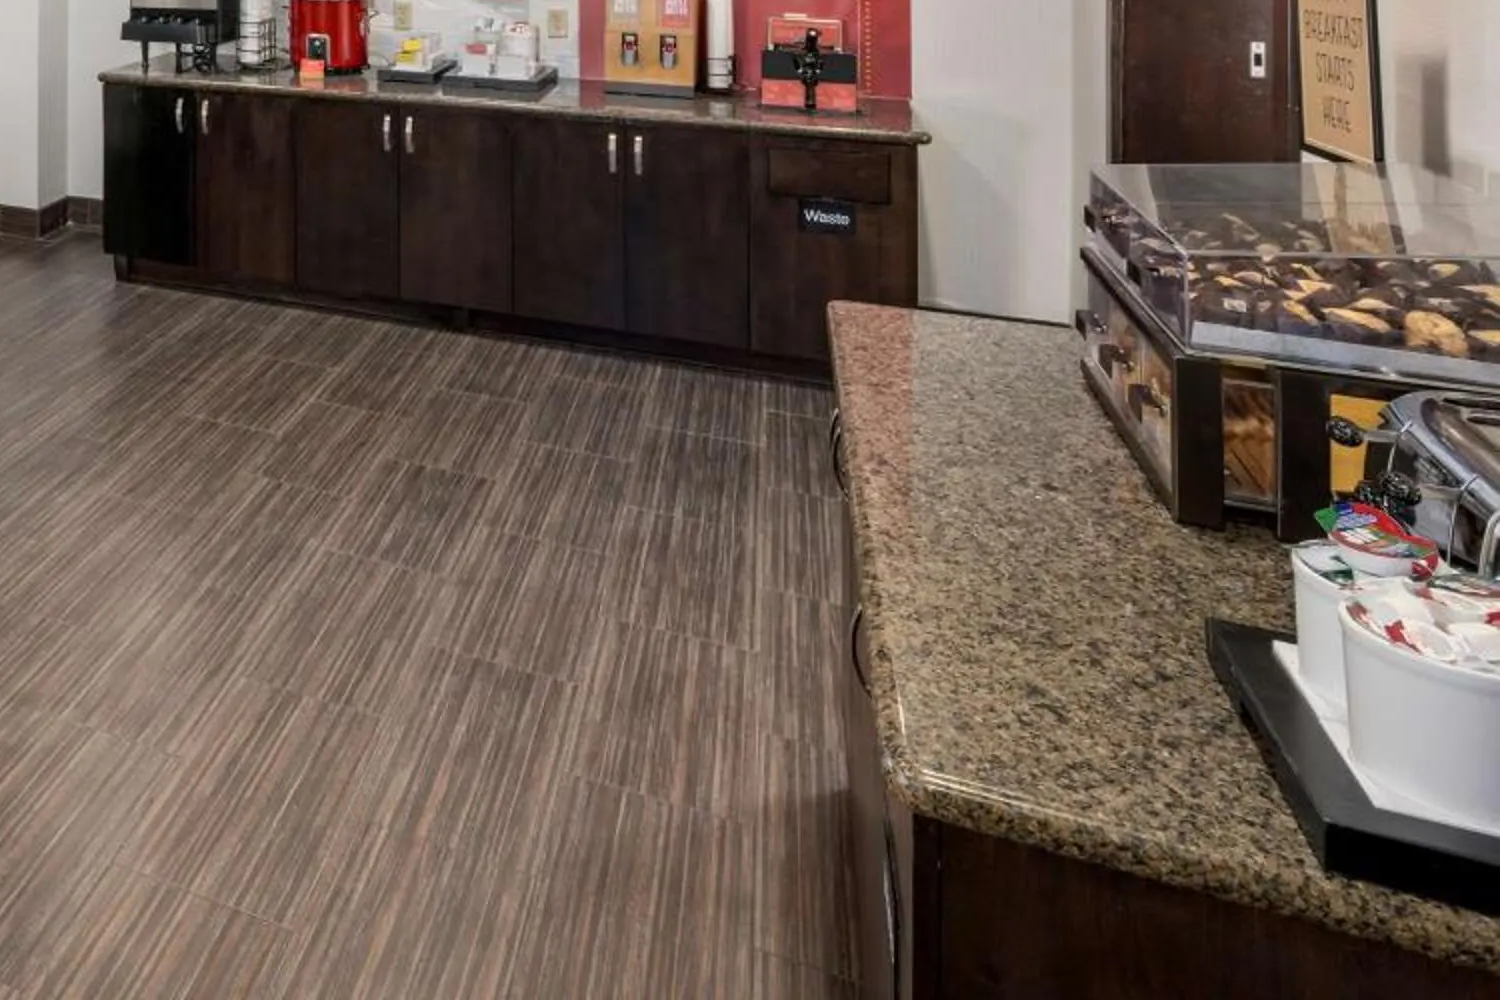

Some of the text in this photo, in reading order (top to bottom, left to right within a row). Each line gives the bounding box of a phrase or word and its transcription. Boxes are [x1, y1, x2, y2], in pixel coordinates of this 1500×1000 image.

[1303, 9, 1363, 49] BREAKFAST
[1316, 53, 1354, 90] STARTS
[1322, 96, 1352, 133] HERE
